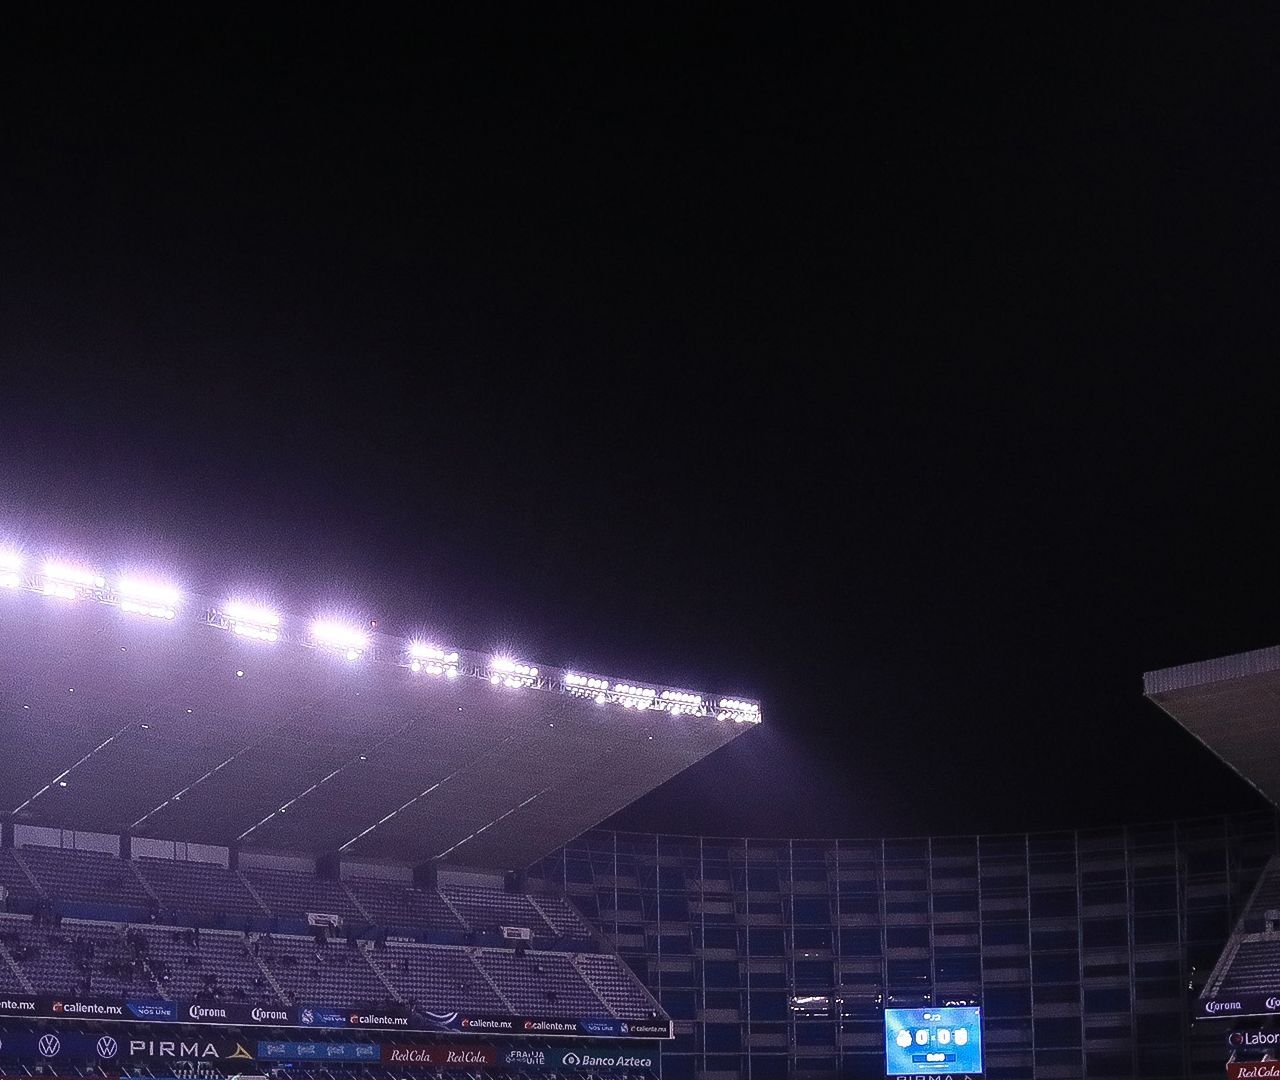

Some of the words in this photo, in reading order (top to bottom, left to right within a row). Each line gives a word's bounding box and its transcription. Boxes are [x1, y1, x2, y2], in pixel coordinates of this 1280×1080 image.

[64, 1004, 122, 1014] caliente.mx
[189, 1005, 225, 1019] Corona
[1205, 1001, 1241, 1013] Corona
[252, 1008, 288, 1021] Corona
[359, 1014, 408, 1026] caliente.mx
[470, 1020, 512, 1029] caliente.mx
[532, 1022, 576, 1031] caliente.mx
[130, 1041, 219, 1057] PIRMA
[583, 1056, 613, 1065] Banco
[616, 1056, 651, 1066] Azteca
